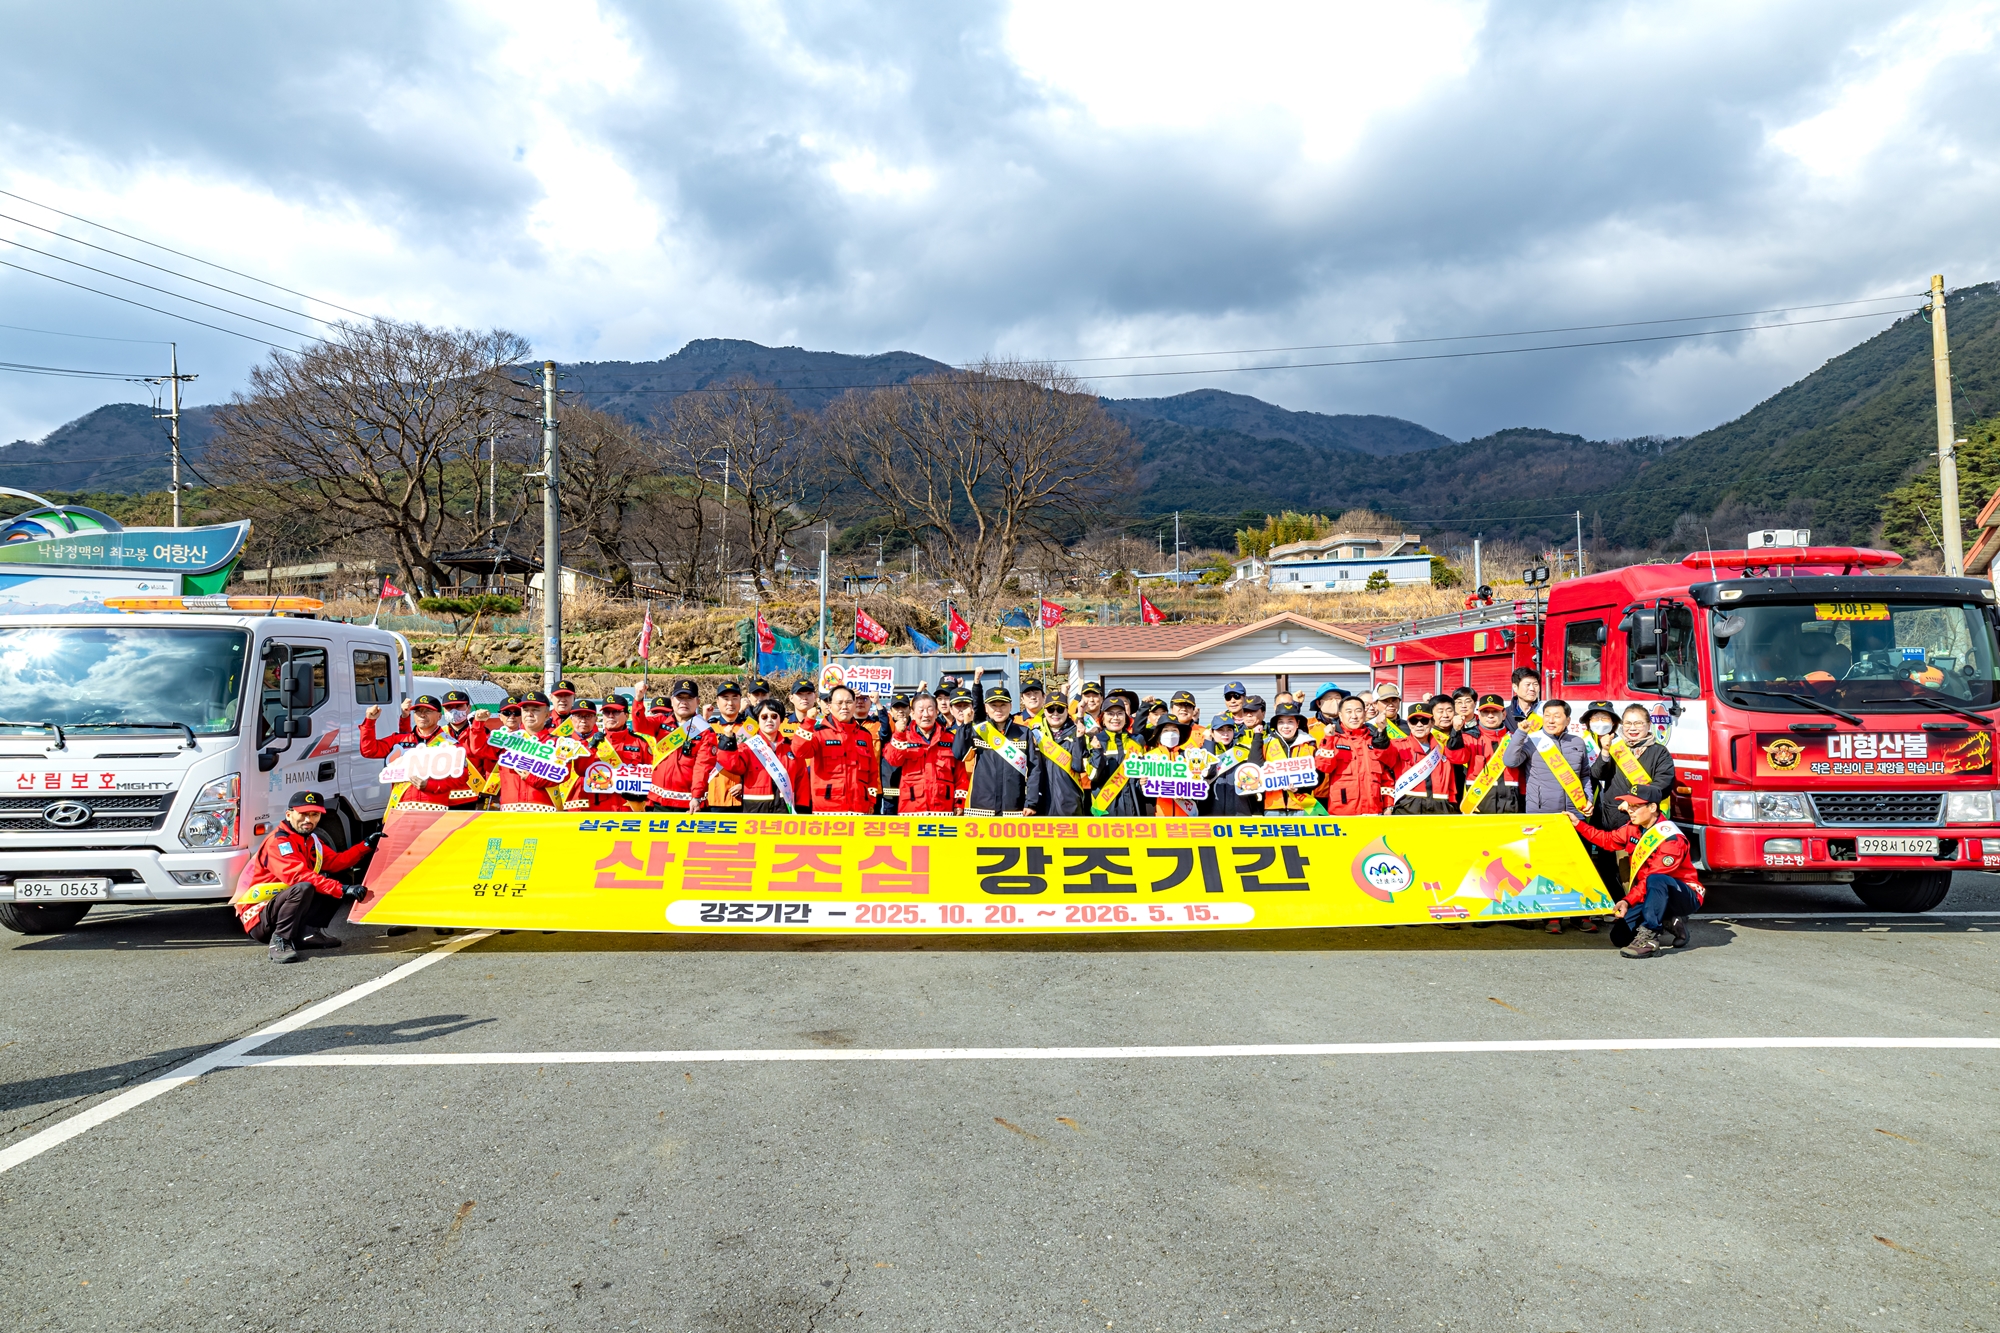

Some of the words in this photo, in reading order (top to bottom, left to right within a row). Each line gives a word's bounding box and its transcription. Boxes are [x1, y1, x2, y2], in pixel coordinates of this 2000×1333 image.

[37, 544, 104, 559] 낙남정맥의
[109, 547, 149, 562] 최고봉
[152, 543, 208, 564] 여항산
[1830, 603, 1858, 615] 가야
[1861, 603, 1872, 615] P
[847, 667, 892, 680] 소각행위
[489, 731, 554, 760] 함께해요
[1826, 733, 1929, 759] 대형산불
[500, 751, 566, 781] 산불예방
[1125, 760, 1187, 779] 함께해요
[1263, 757, 1313, 775] 소각행위
[1810, 762, 1831, 775] 작은
[1833, 762, 1862, 774] 관심이
[1864, 762, 1874, 774] 큰
[1876, 762, 1905, 774] 재앙을
[1907, 762, 1945, 774] 막습니다
[116, 782, 173, 790] MIGHTY
[285, 771, 316, 784] HAMAN
[1265, 771, 1316, 789] 이제그만
[1144, 779, 1207, 798] 산불예방
[579, 820, 643, 832] 실수로
[649, 820, 669, 832] 낸
[676, 820, 738, 834] 산불도
[744, 820, 854, 836] 3년이하의
[863, 822, 911, 837] 징역
[917, 824, 958, 837] 또는
[1087, 823, 1157, 838] 이하의
[1166, 823, 1233, 838] 벌금이
[1240, 824, 1347, 838] 부과됩니다.
[1901, 839, 1933, 852] 1692
[594, 841, 929, 895] 산불조심
[977, 845, 1311, 895] 강조기간
[1763, 854, 1805, 866] 경남소방
[24, 883, 53, 897] 89노
[60, 883, 98, 896] 0563
[473, 883, 527, 897] 함안군
[700, 902, 812, 924] 강조기간
[855, 903, 926, 923] 2025.
[938, 904, 972, 923] 10.
[984, 905, 1024, 923] 20.
[1065, 905, 1137, 923] 2026.
[1148, 905, 1173, 921] 5.
[1184, 905, 1219, 921] 15.
